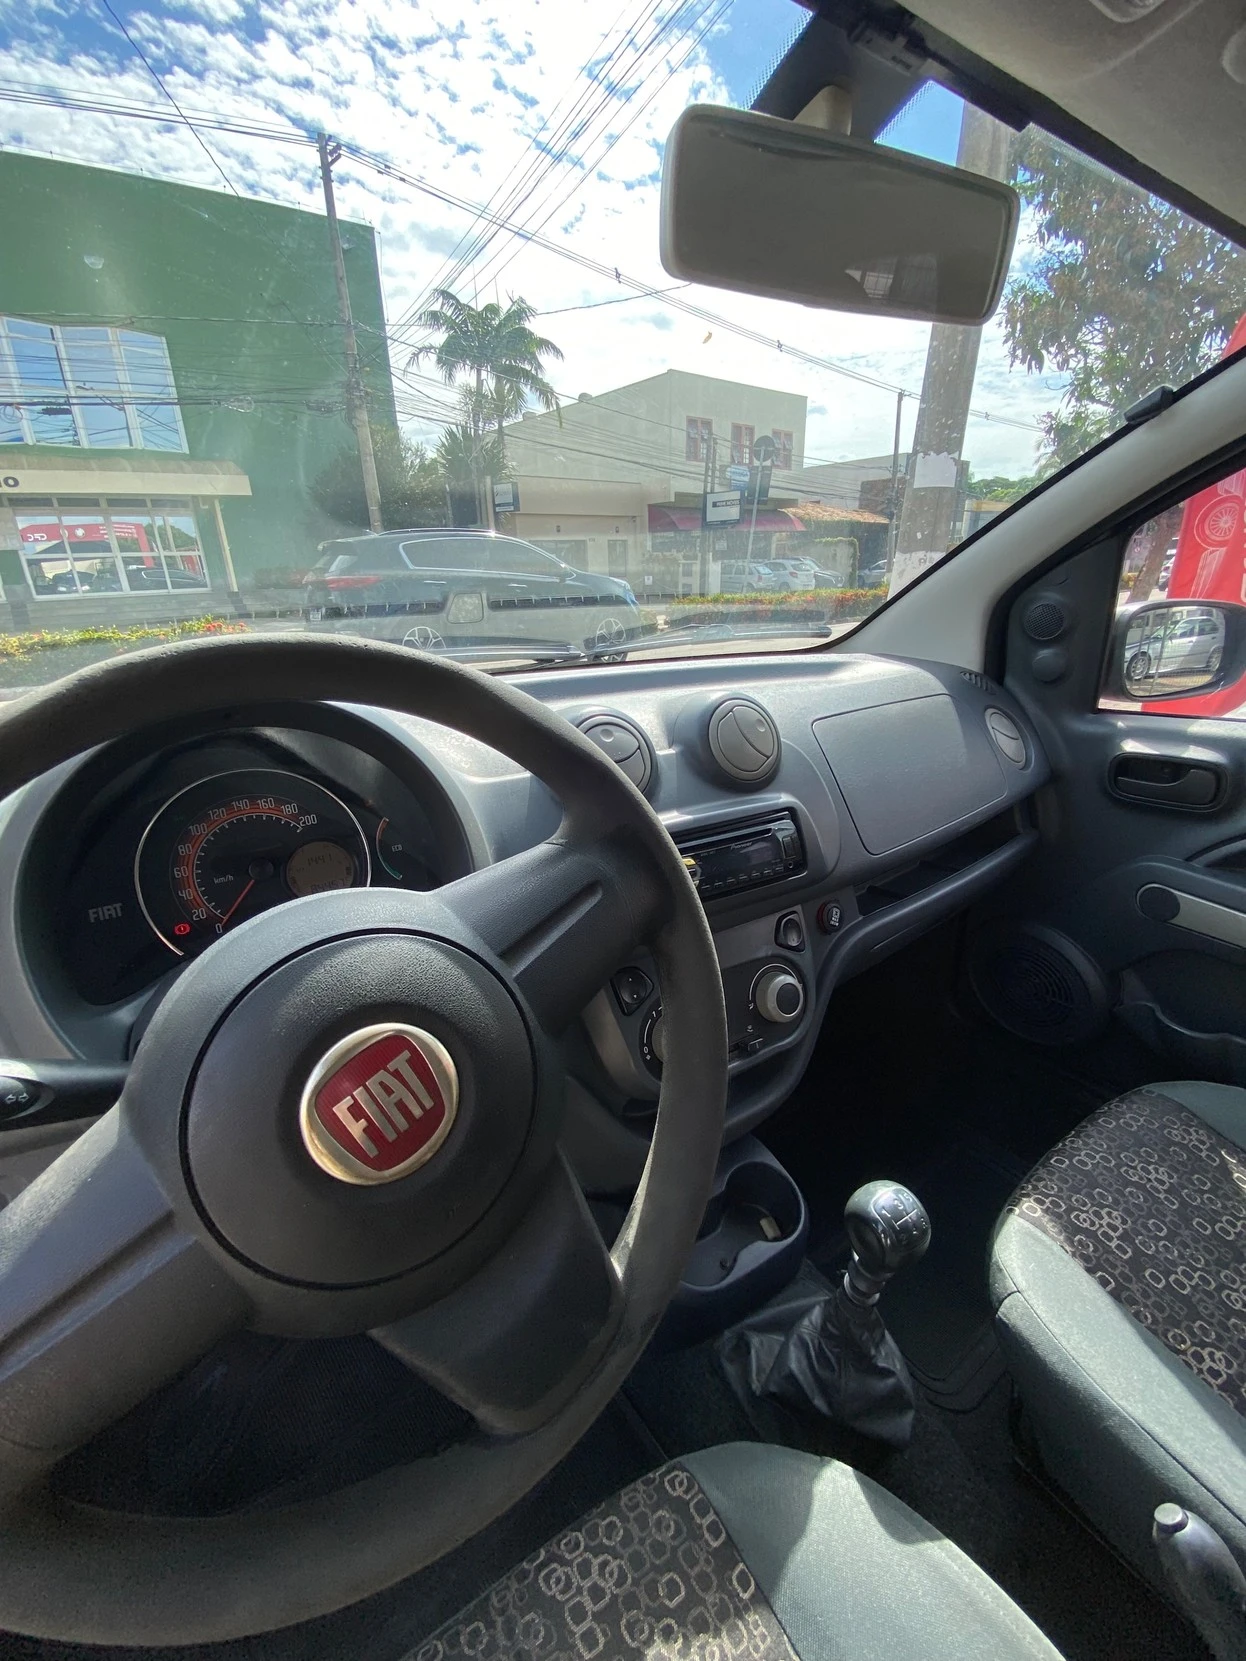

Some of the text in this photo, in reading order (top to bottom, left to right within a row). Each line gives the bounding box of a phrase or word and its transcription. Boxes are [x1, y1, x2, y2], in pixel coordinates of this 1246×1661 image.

[231, 799, 250, 811] 140
[257, 798, 275, 810] 160
[281, 803, 299, 815] 180
[208, 808, 227, 821] 120
[298, 814, 318, 827] 200
[188, 823, 208, 836] 100
[178, 843, 193, 856] 80
[174, 866, 189, 878] 60
[213, 874, 234, 884] km/h
[178, 888, 194, 901] 40
[88, 903, 122, 923] FIAT
[192, 908, 207, 921] 20
[215, 923, 223, 934] 0
[332, 1050, 435, 1158] FIAT
[893, 1199, 904, 1210] 3
[903, 1192, 913, 1203] 5
